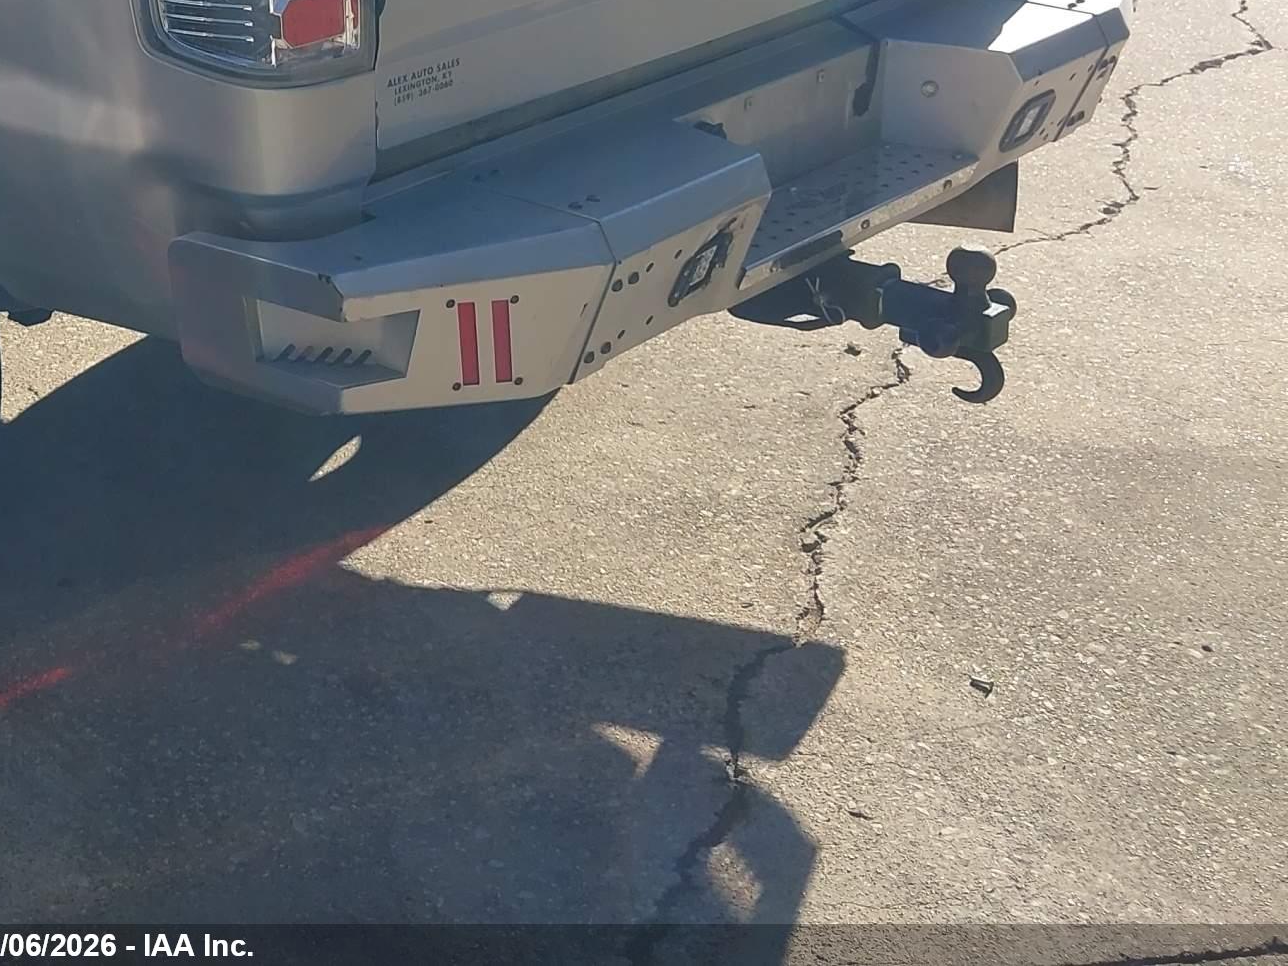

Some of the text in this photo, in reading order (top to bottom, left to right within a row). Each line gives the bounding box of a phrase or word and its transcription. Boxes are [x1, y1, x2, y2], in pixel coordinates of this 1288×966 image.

[387, 57, 460, 87] ALEX AUTO SALES
[442, 71, 453, 80] KY
